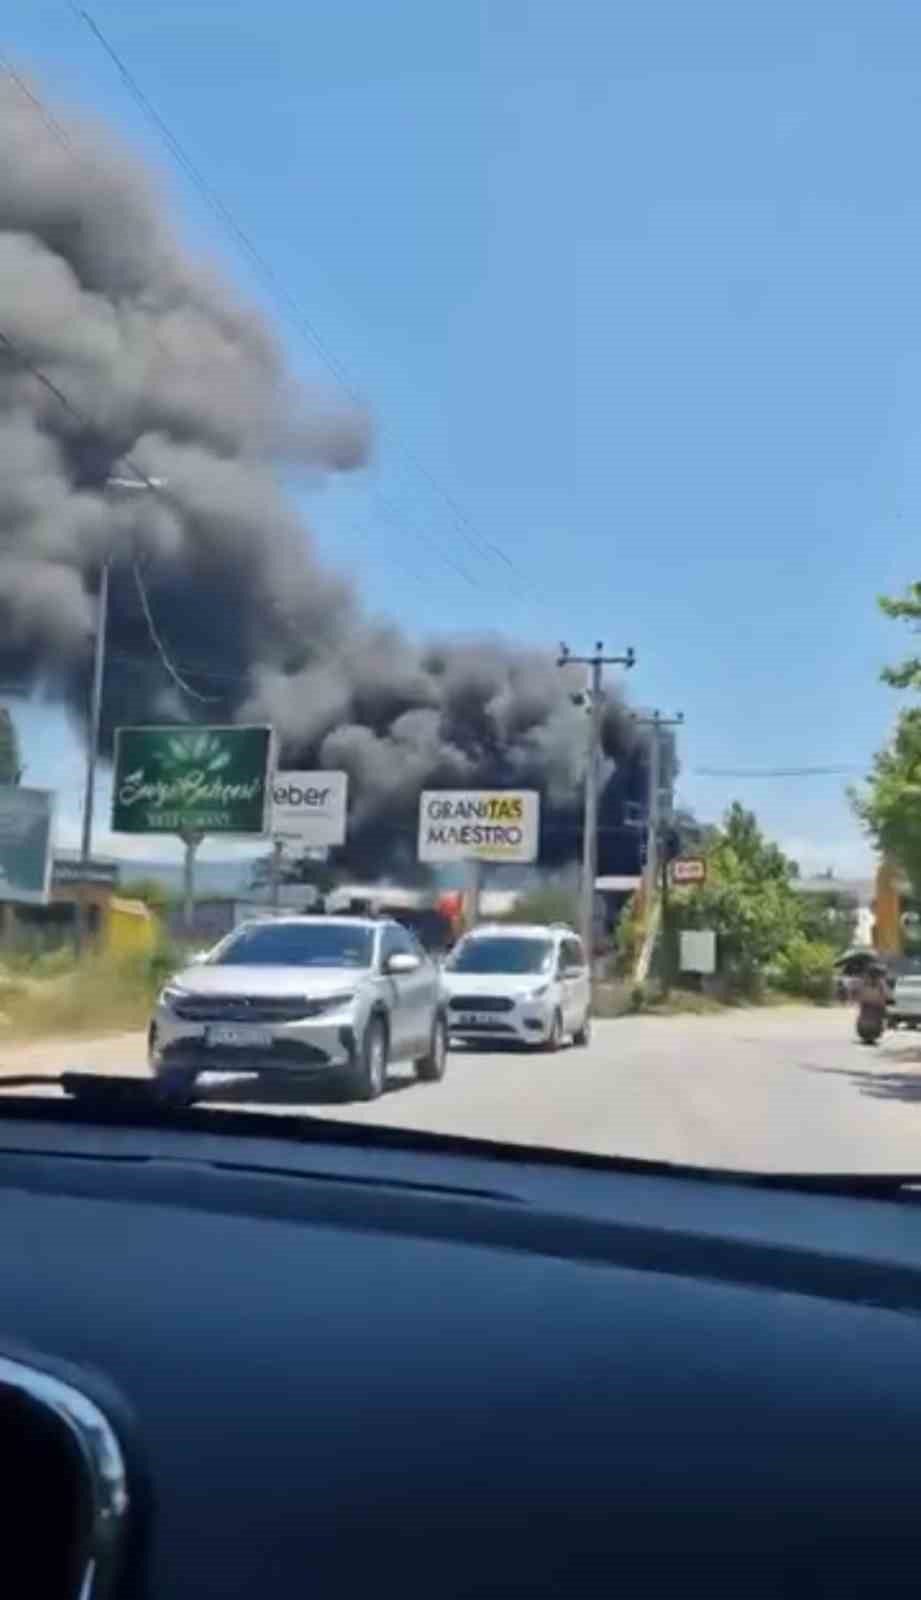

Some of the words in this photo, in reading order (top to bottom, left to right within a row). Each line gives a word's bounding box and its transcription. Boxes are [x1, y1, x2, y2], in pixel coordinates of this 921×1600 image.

[272, 783, 331, 806] eber
[427, 799, 523, 820] GRANITAS
[427, 826, 523, 845] MAESTRO
